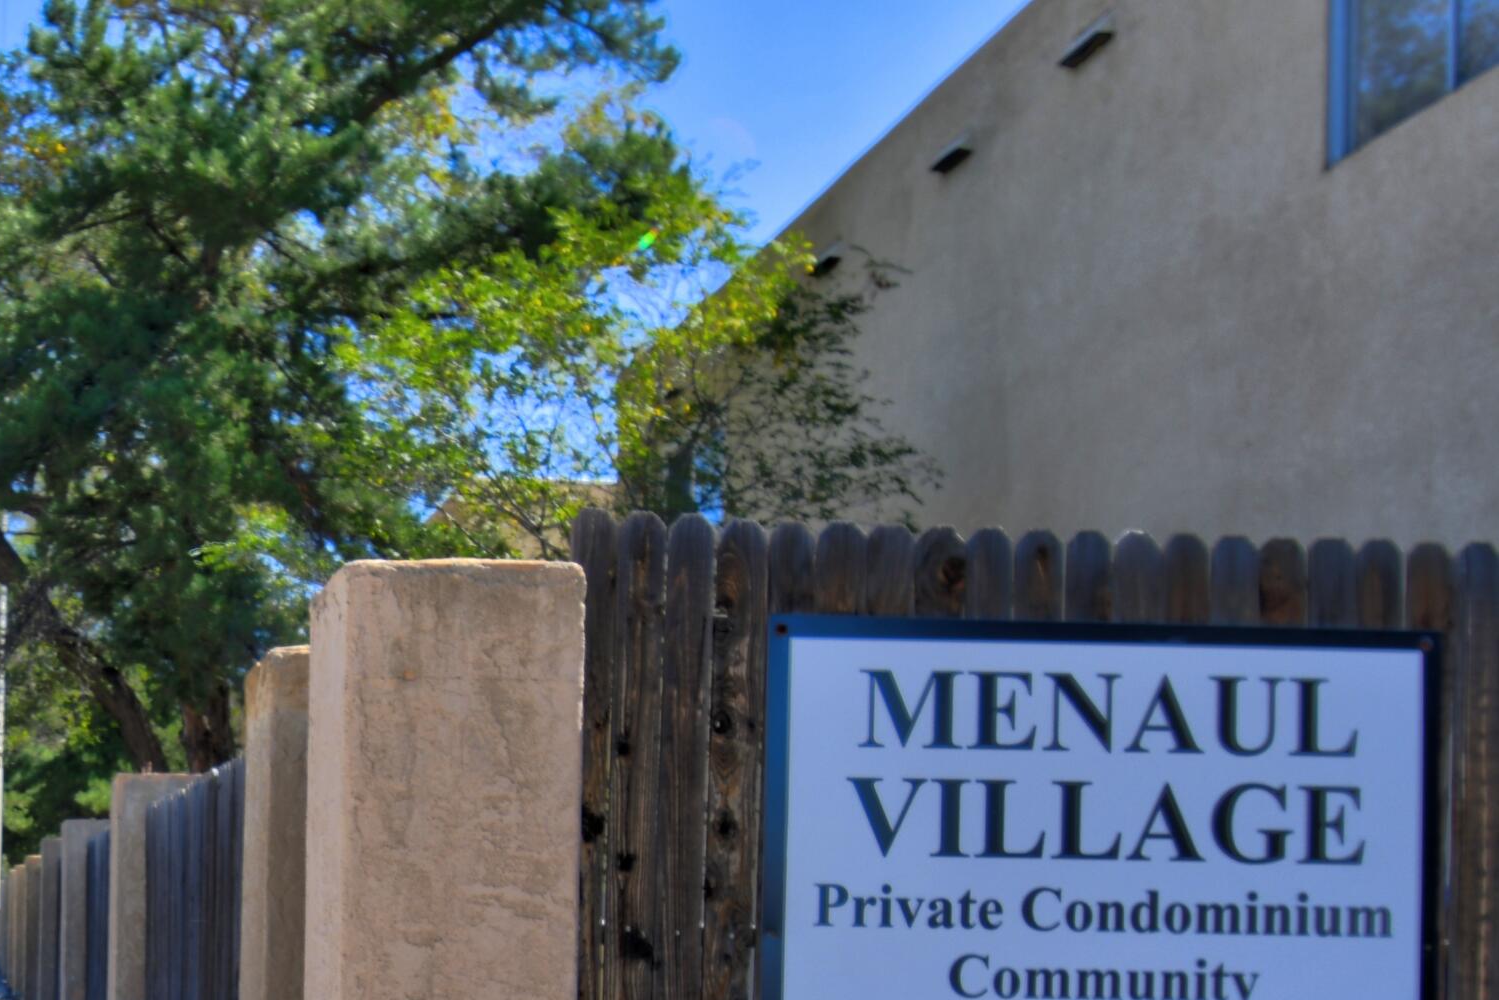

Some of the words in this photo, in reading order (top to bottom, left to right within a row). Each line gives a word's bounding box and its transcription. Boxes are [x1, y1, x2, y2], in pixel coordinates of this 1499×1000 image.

[857, 668, 1358, 757] MENAUL
[846, 776, 1365, 865] VILLAGE
[812, 882, 1003, 930] Private
[1020, 887, 1392, 937] Condominium
